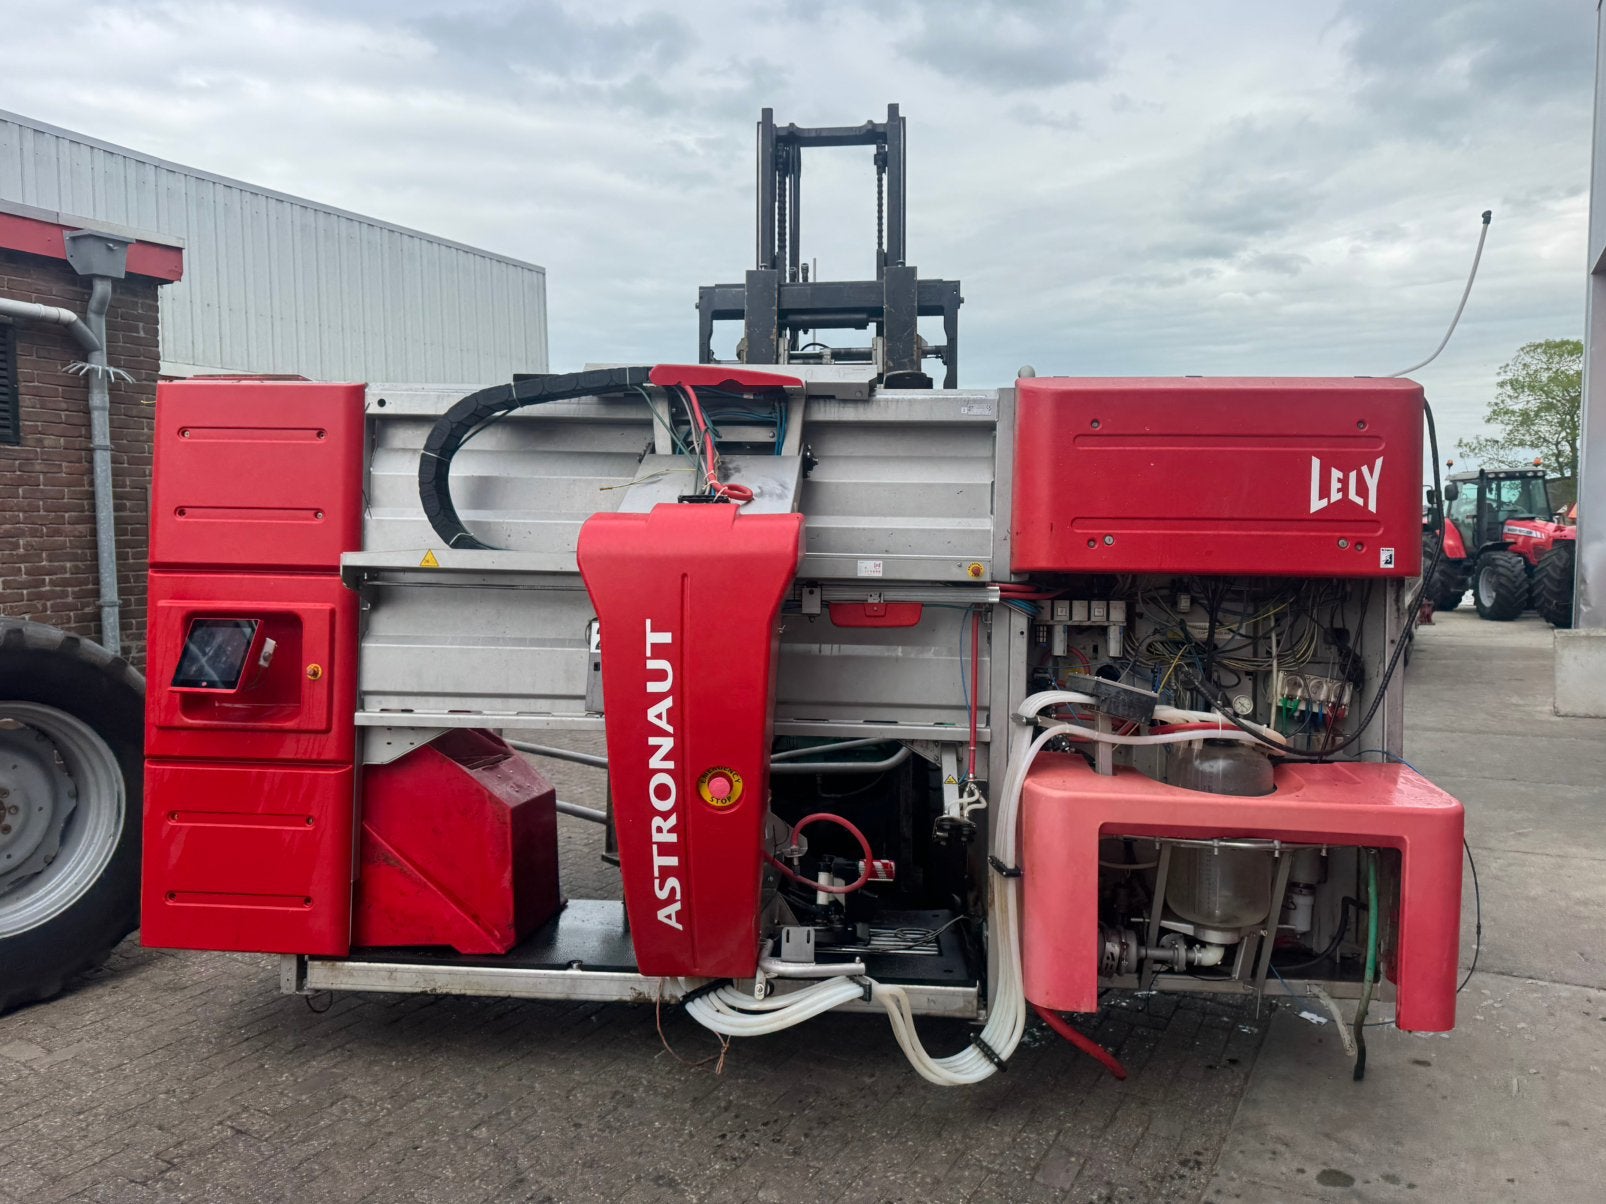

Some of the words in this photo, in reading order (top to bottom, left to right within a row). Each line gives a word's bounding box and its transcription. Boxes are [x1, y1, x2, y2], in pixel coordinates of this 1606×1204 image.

[1310, 455, 1384, 514] LELY
[645, 618, 683, 931] ASTRONAUT
[701, 766, 741, 784] EMERGENCY
[710, 796, 731, 804] STOP
